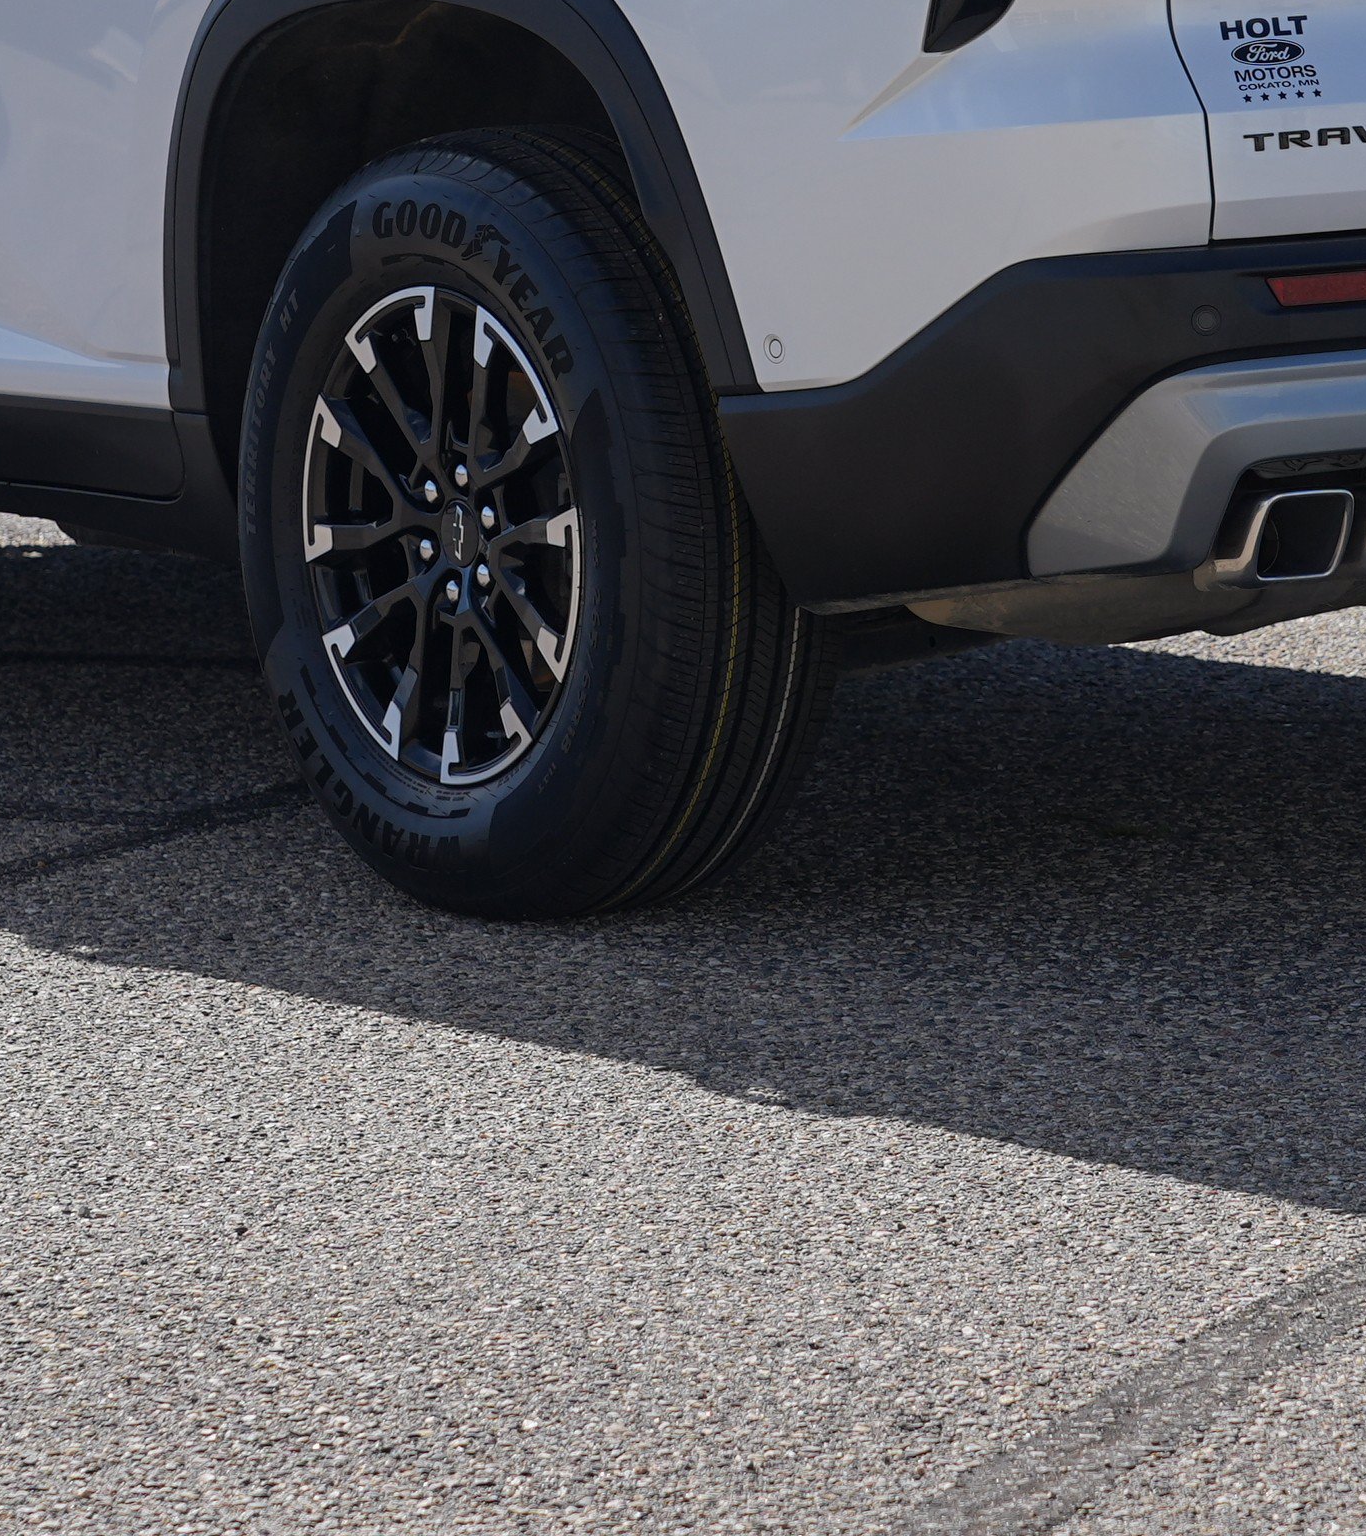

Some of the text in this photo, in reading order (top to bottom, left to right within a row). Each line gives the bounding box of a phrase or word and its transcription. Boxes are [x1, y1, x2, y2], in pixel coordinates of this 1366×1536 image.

[1219, 15, 1307, 40] HOLT
[1247, 44, 1290, 62] Ford
[1234, 65, 1317, 82] MOTORS
[1239, 81, 1295, 91] COKATO,
[371, 199, 575, 380] GOODYEAR
[245, 341, 277, 536] TERRITORY
